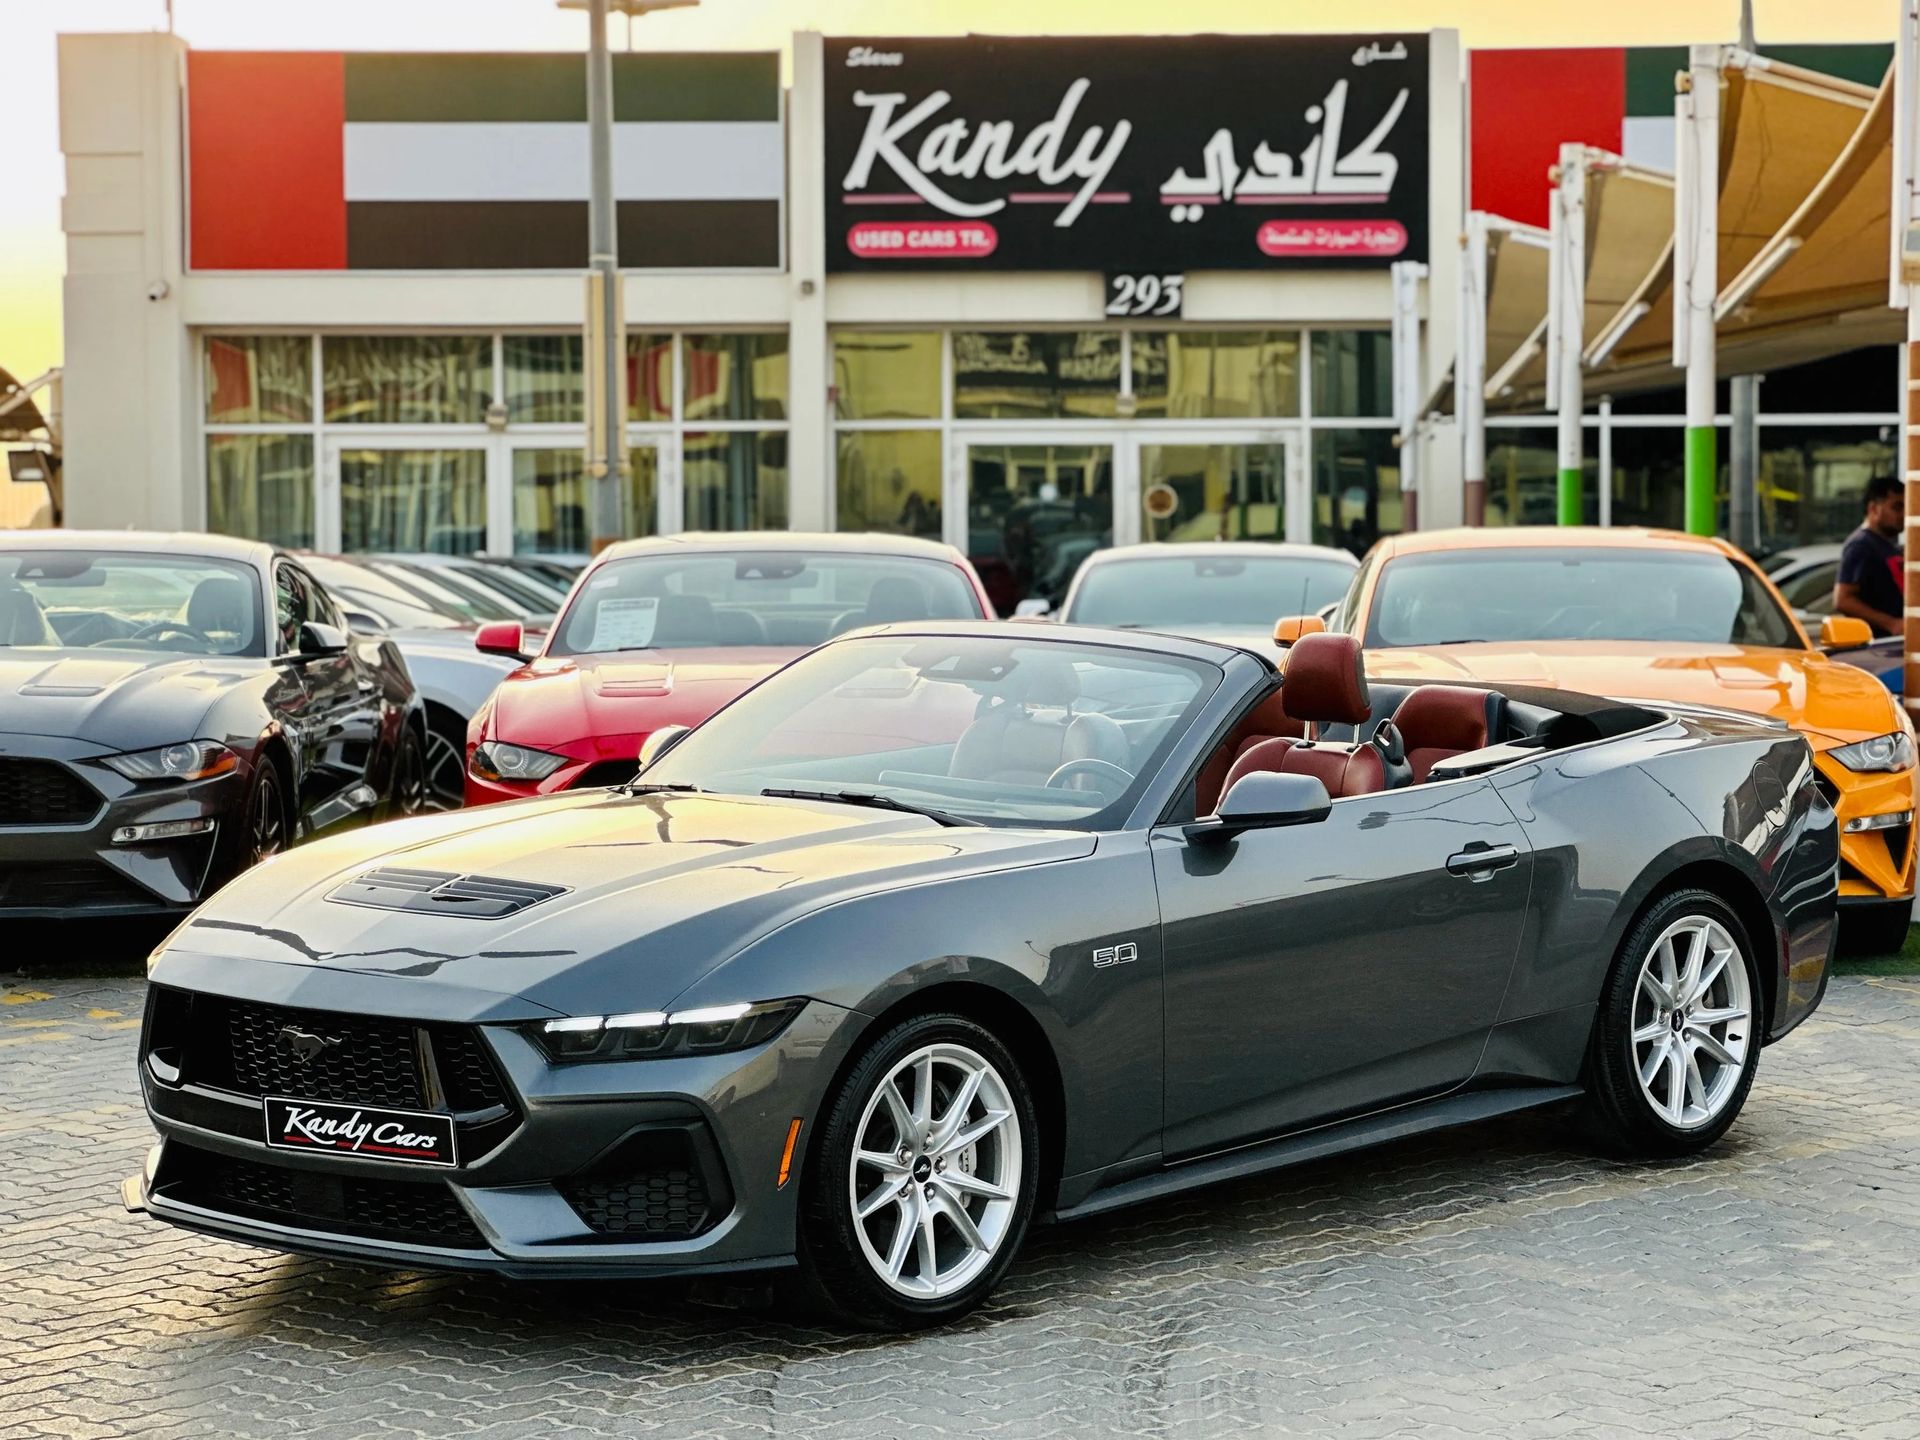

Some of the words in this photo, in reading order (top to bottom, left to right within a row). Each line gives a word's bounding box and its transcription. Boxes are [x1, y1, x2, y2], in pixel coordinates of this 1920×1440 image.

[843, 77, 1132, 227] Kandy
[1159, 78, 1410, 223] كاندي
[854, 229, 905, 249] USED
[906, 229, 958, 248] CARS
[1105, 274, 1184, 316] 293
[1093, 942, 1138, 969] 5.0
[283, 1105, 373, 1151] Kandy
[372, 1122, 438, 1149] Cars
